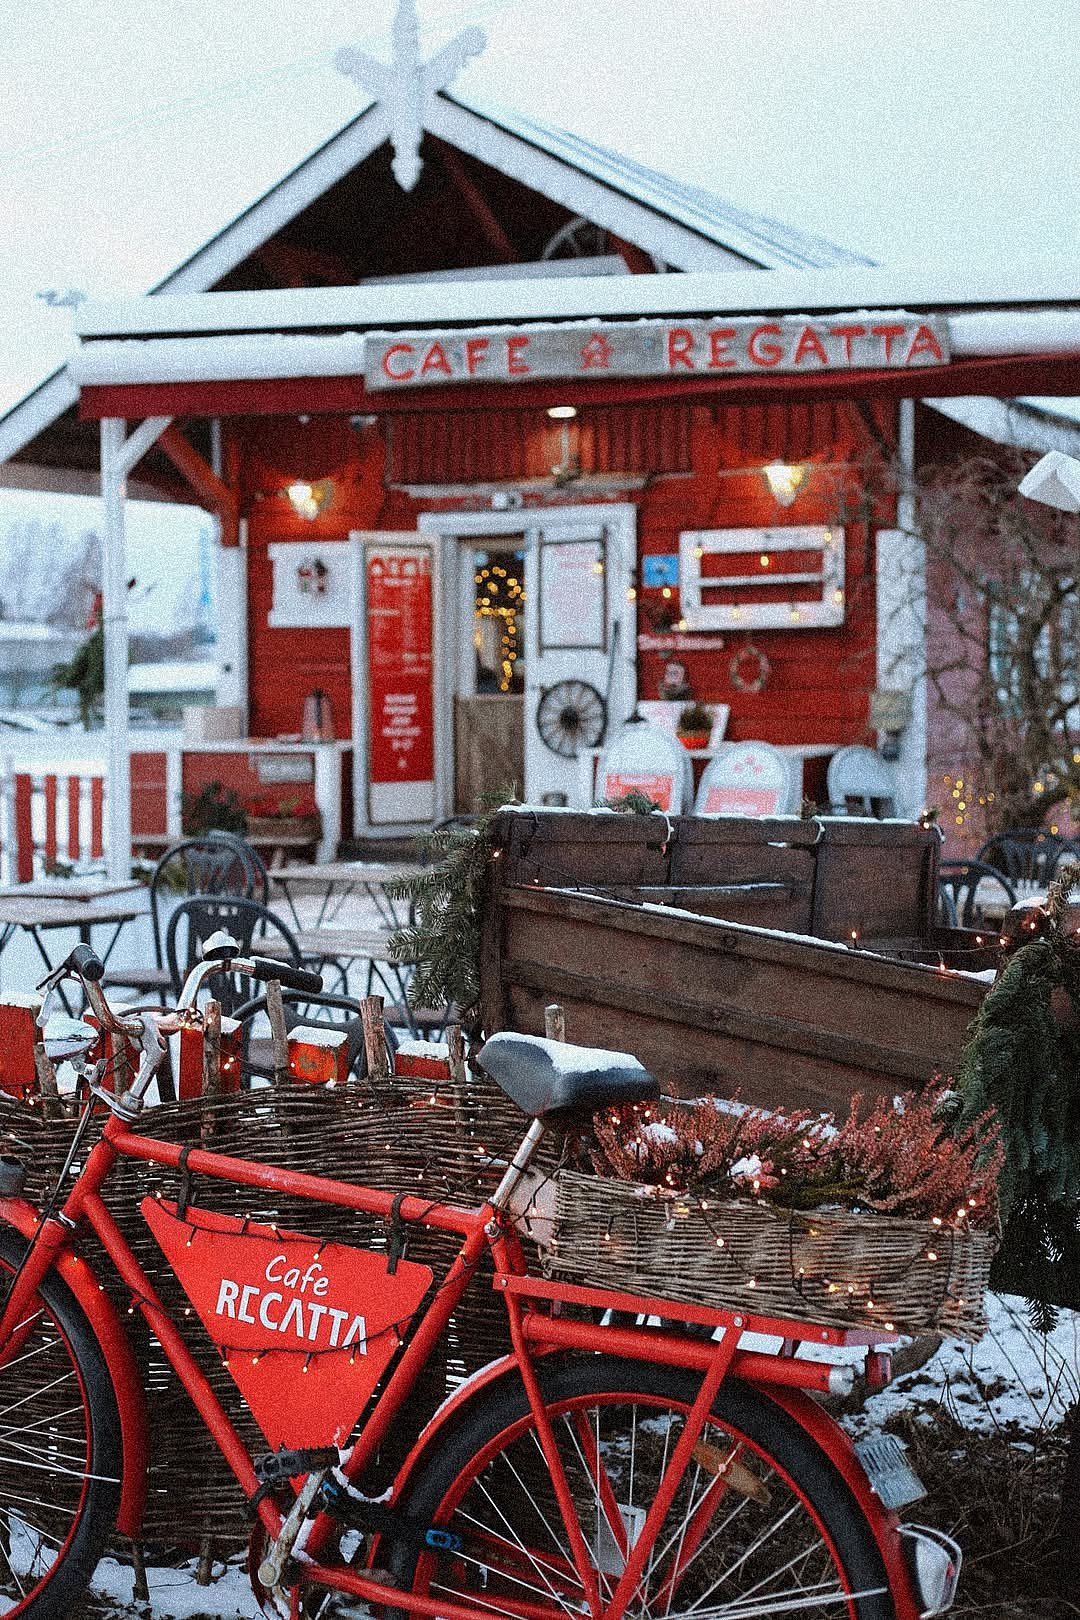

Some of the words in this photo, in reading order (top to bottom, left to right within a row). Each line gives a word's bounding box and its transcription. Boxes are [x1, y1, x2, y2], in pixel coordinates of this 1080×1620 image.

[381, 335, 531, 381] CAFE
[666, 323, 944, 370] REGATTA
[265, 1254, 329, 1297] Cafe
